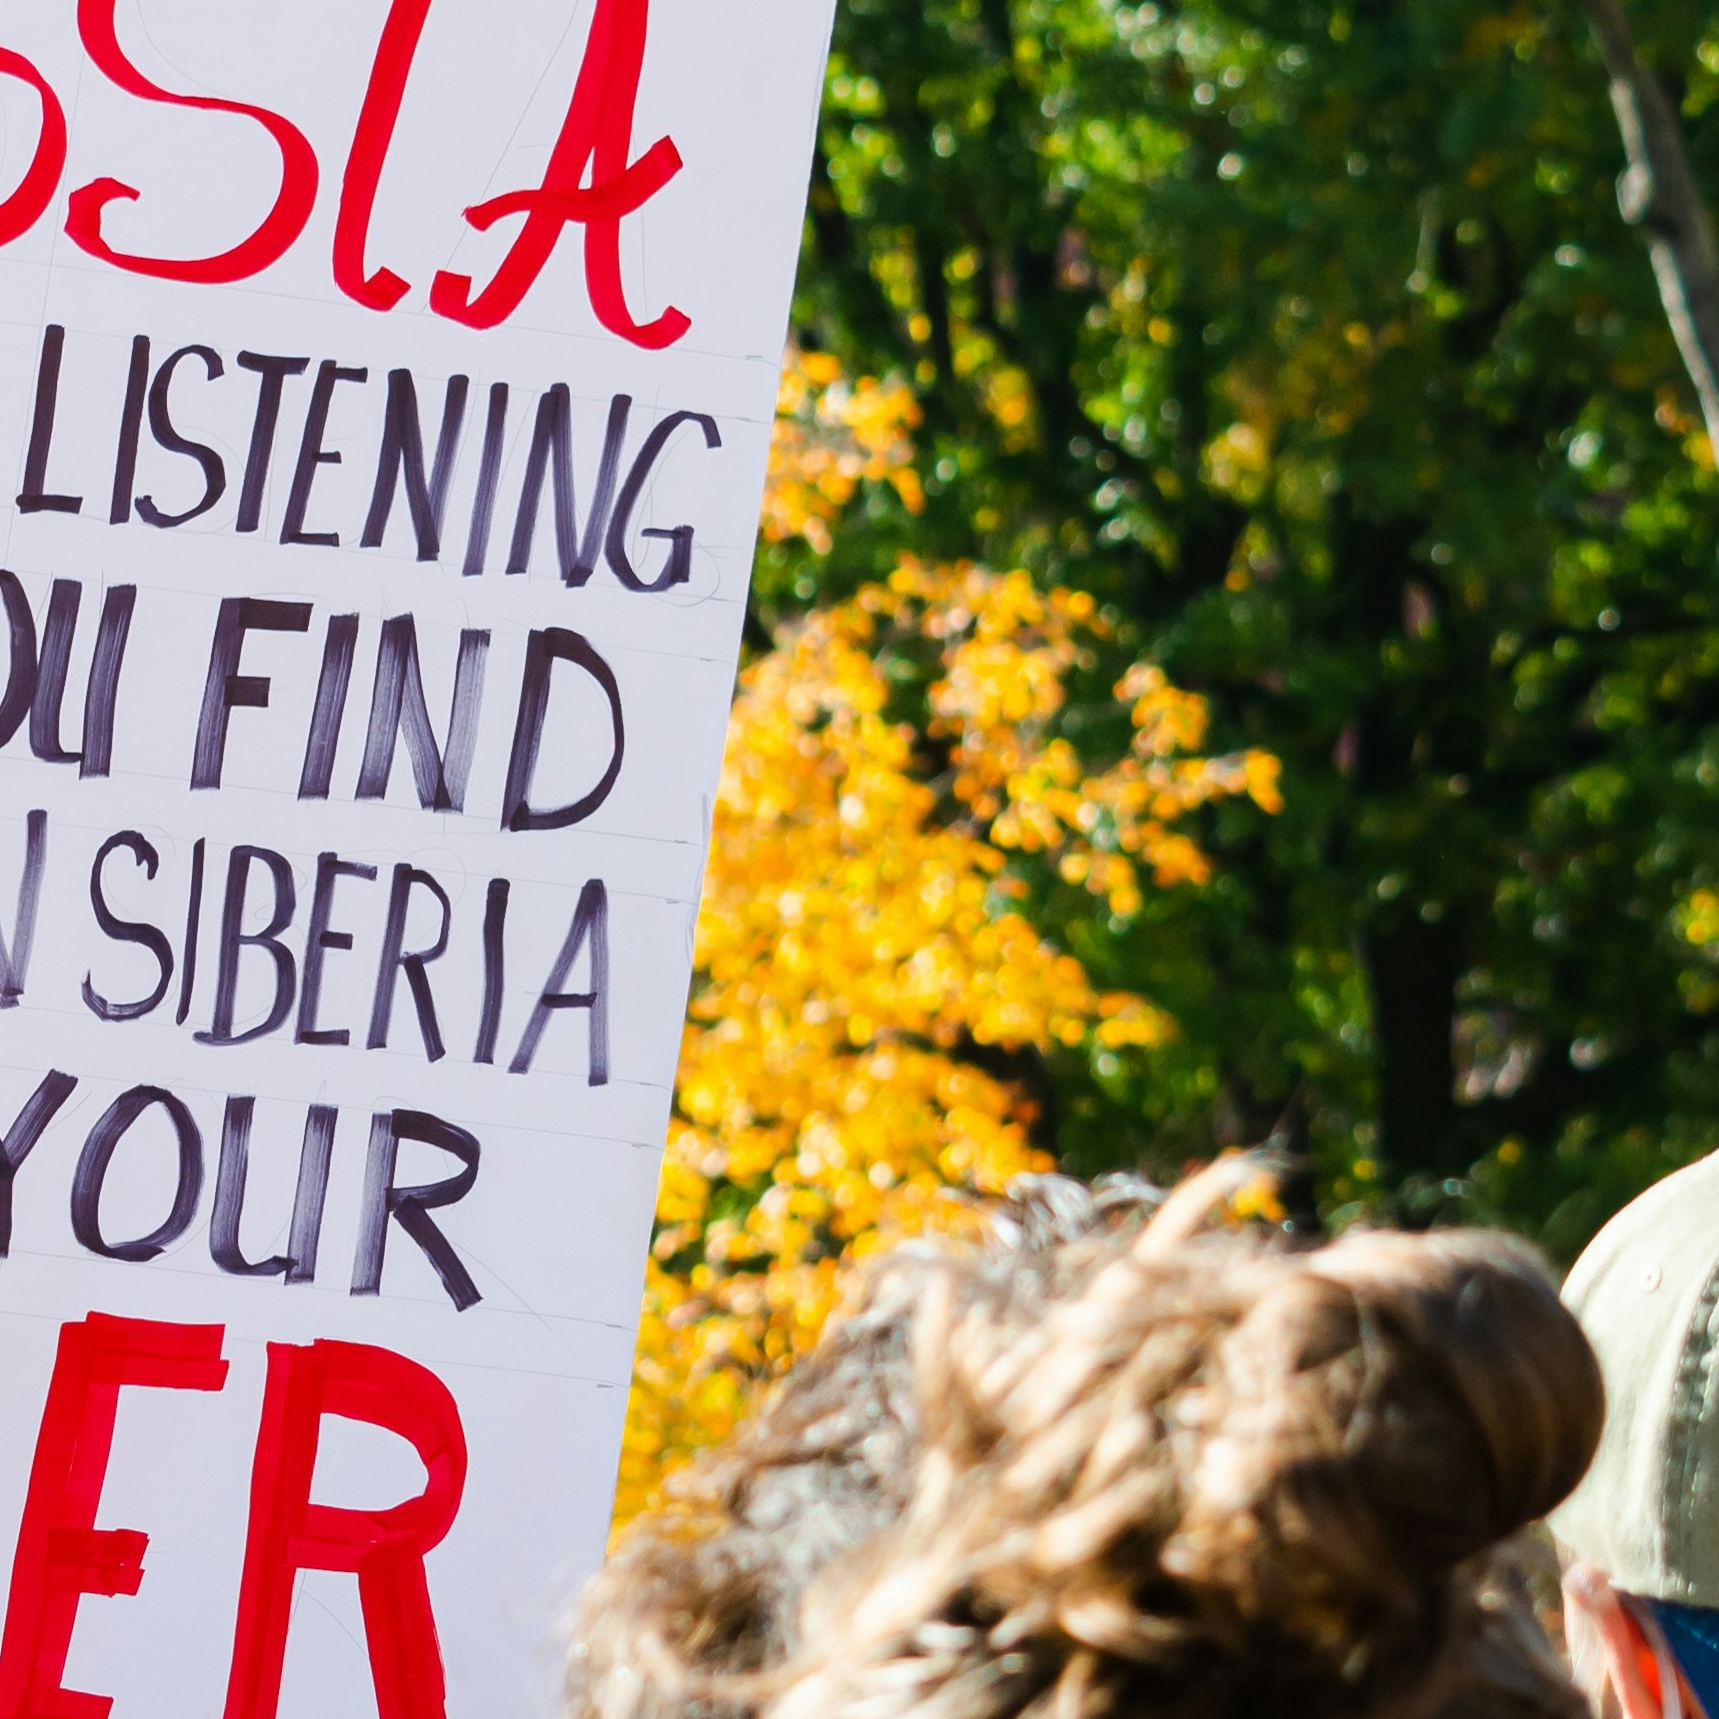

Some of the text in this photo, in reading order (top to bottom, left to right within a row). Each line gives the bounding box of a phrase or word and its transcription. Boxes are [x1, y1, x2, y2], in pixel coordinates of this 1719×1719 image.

[16, 325, 721, 592] LISTENING
[190, 597, 624, 832] FIND
[82, 830, 608, 1090] SIBERIA
